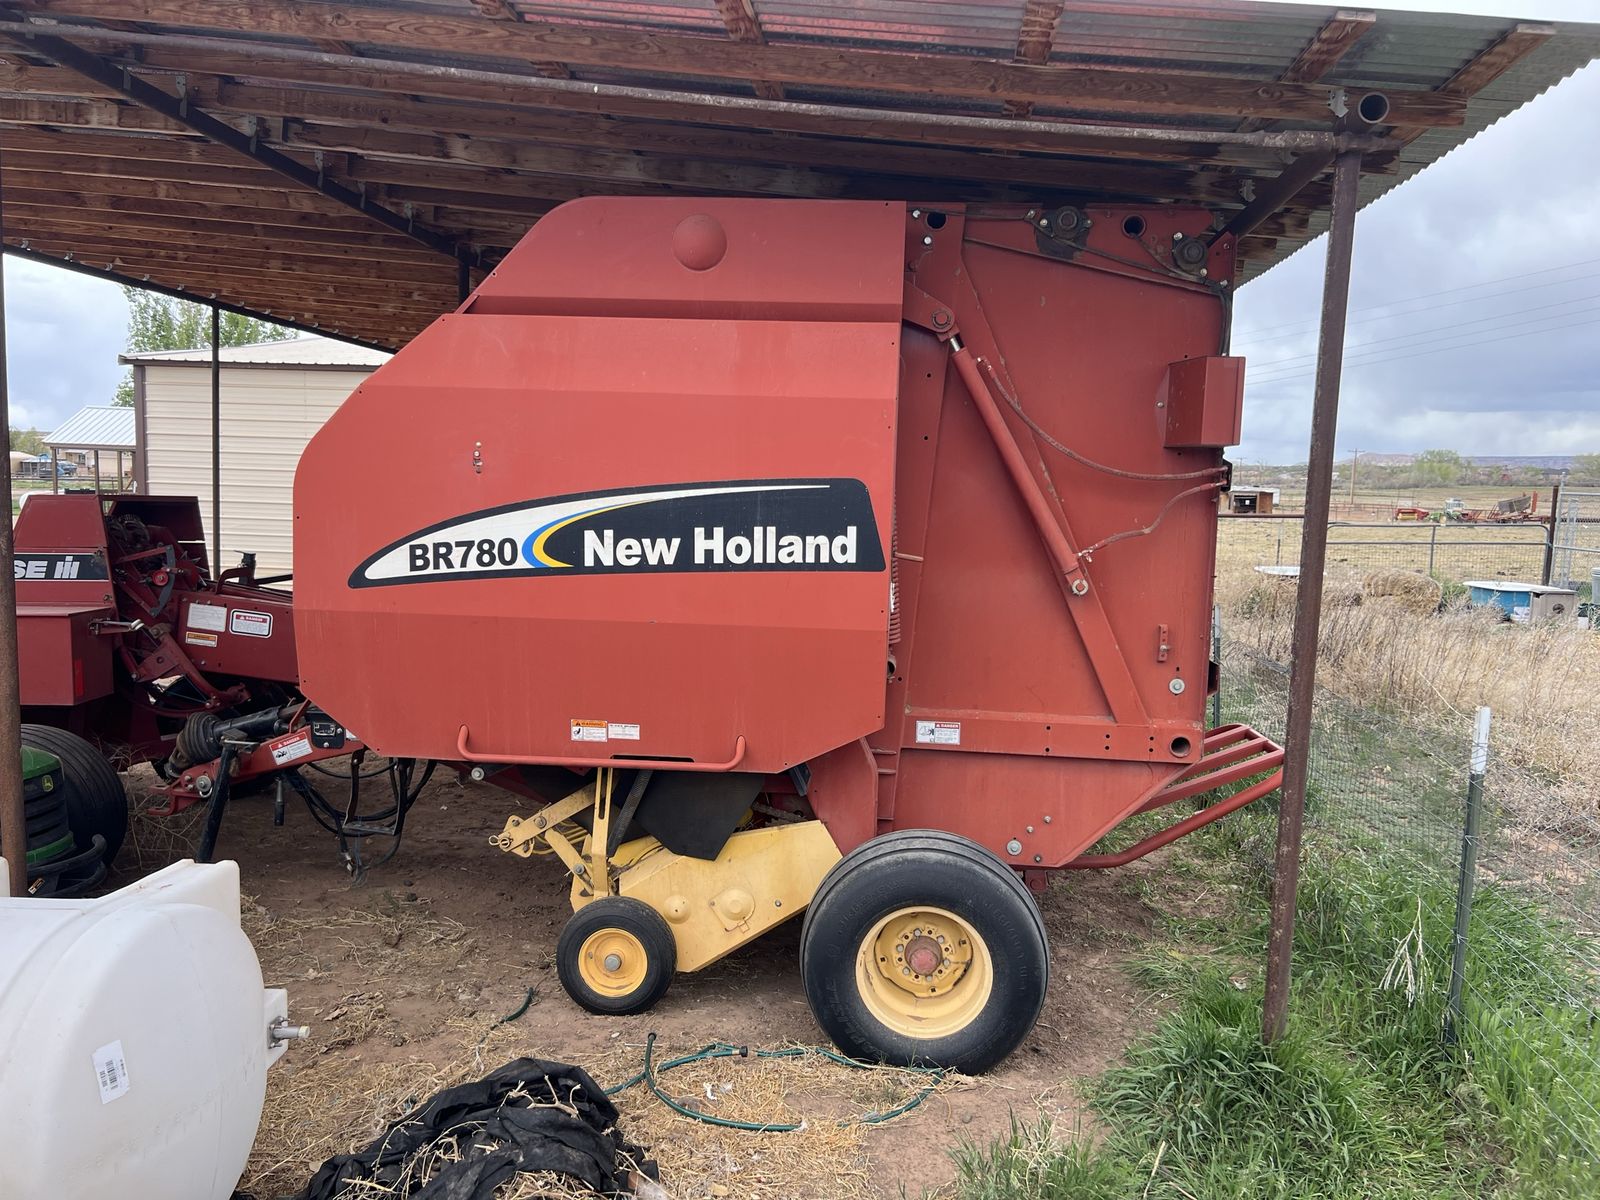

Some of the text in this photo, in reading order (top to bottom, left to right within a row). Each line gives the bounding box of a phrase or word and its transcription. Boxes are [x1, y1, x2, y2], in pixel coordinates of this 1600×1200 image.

[409, 537, 518, 572] BR780
[584, 526, 857, 567] New Holland
